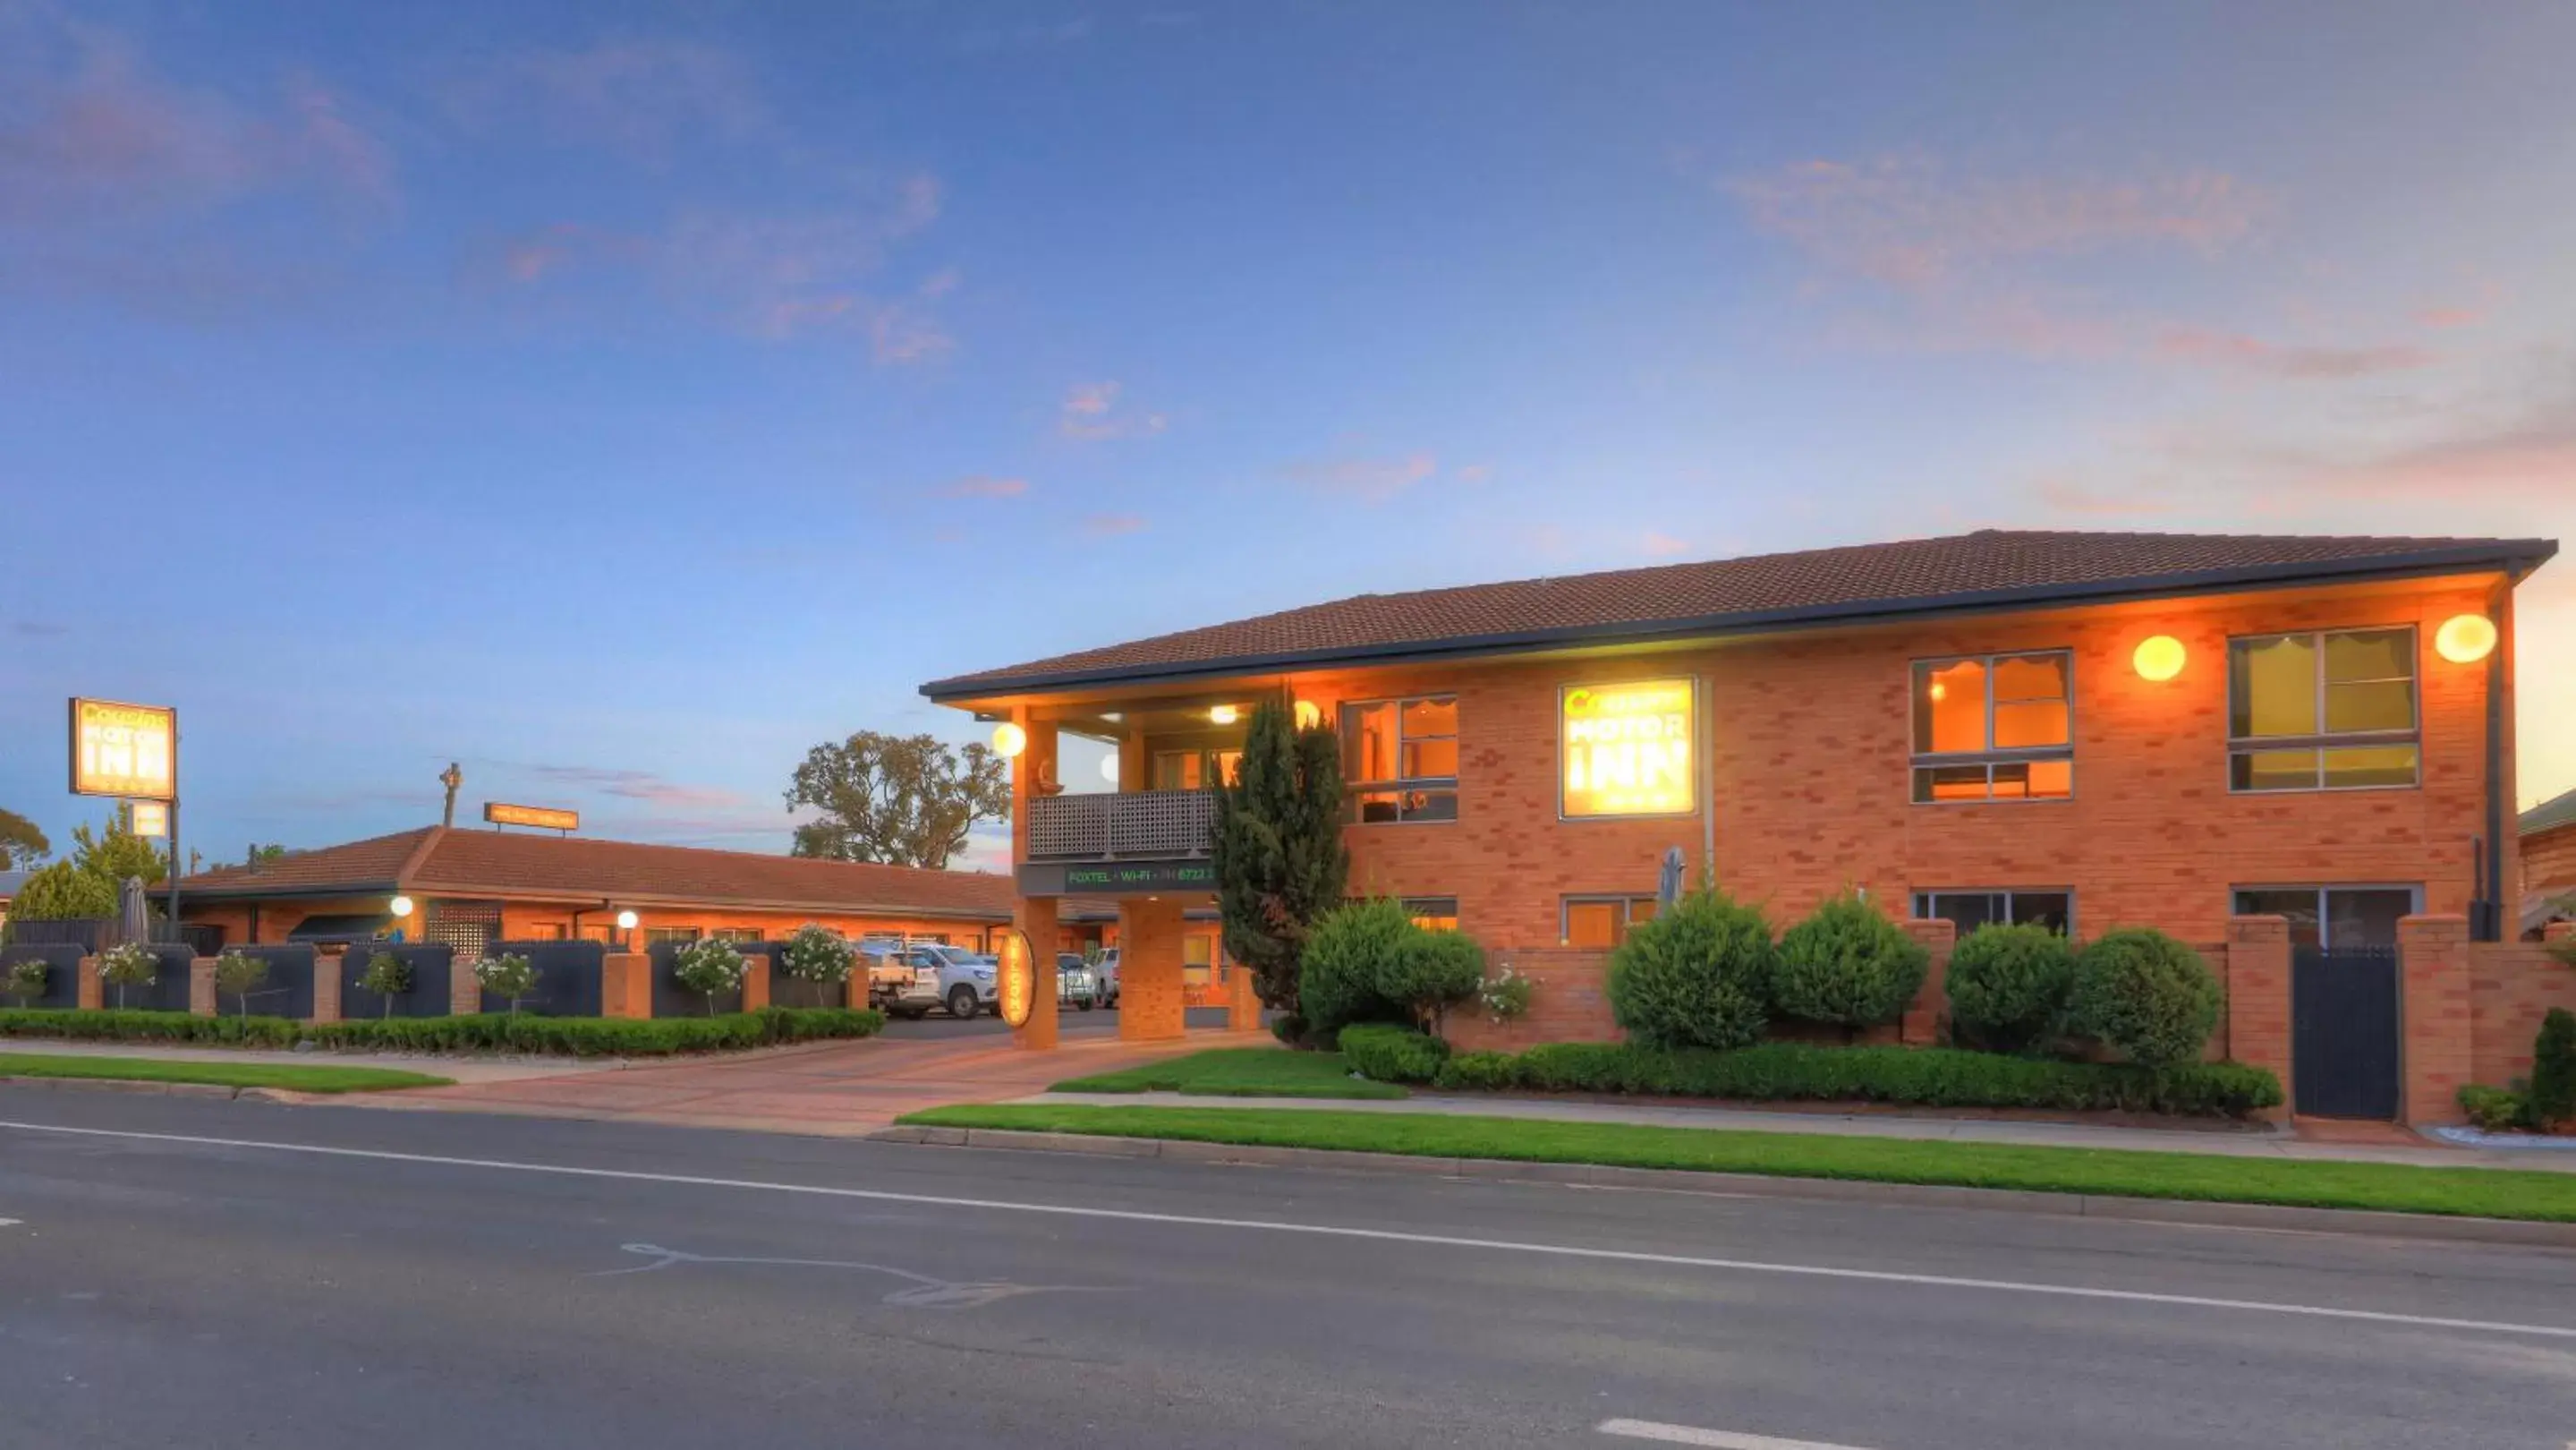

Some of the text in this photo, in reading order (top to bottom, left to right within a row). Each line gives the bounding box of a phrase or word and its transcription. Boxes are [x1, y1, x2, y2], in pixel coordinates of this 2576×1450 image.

[1569, 713, 1686, 742] MOTOR
[1569, 739, 1688, 791] INN
[1069, 871, 1111, 883] FOXTEL
